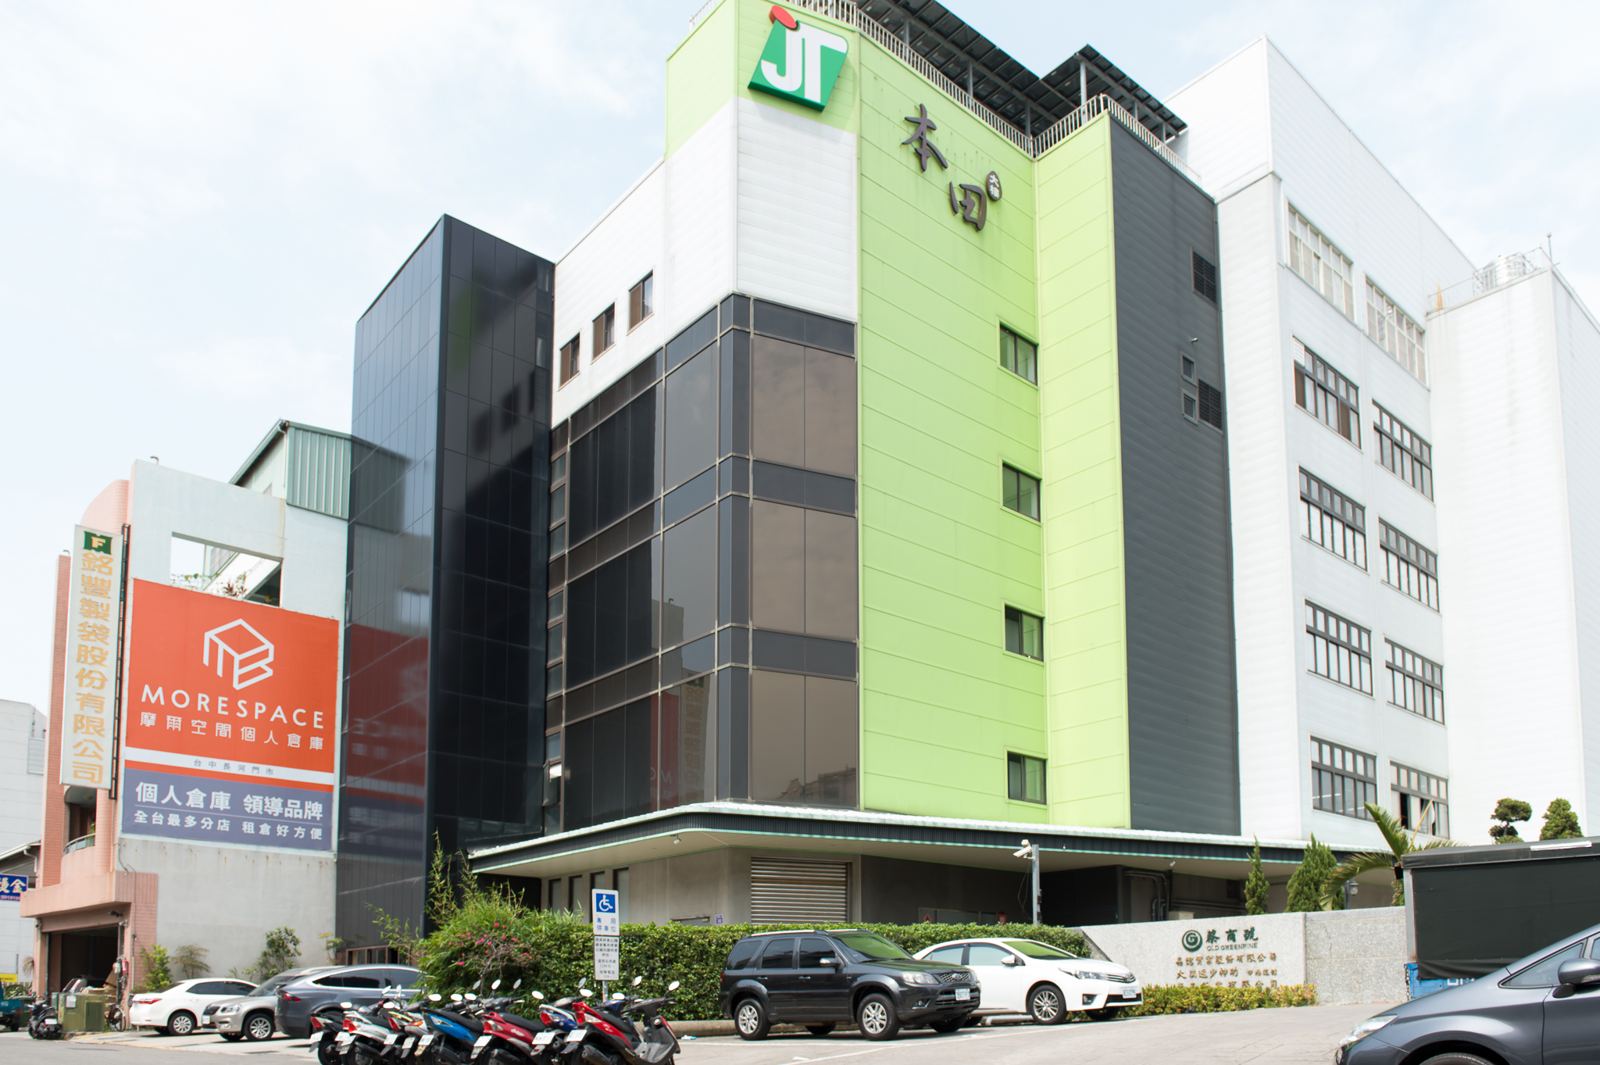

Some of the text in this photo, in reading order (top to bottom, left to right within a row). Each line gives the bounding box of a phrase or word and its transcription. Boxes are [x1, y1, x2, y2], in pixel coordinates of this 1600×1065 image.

[760, 20, 848, 103] JT
[135, 782, 323, 821] 個人倉庫 領導品牌
[134, 810, 323, 841] 全台最多分店 租倉好方便
